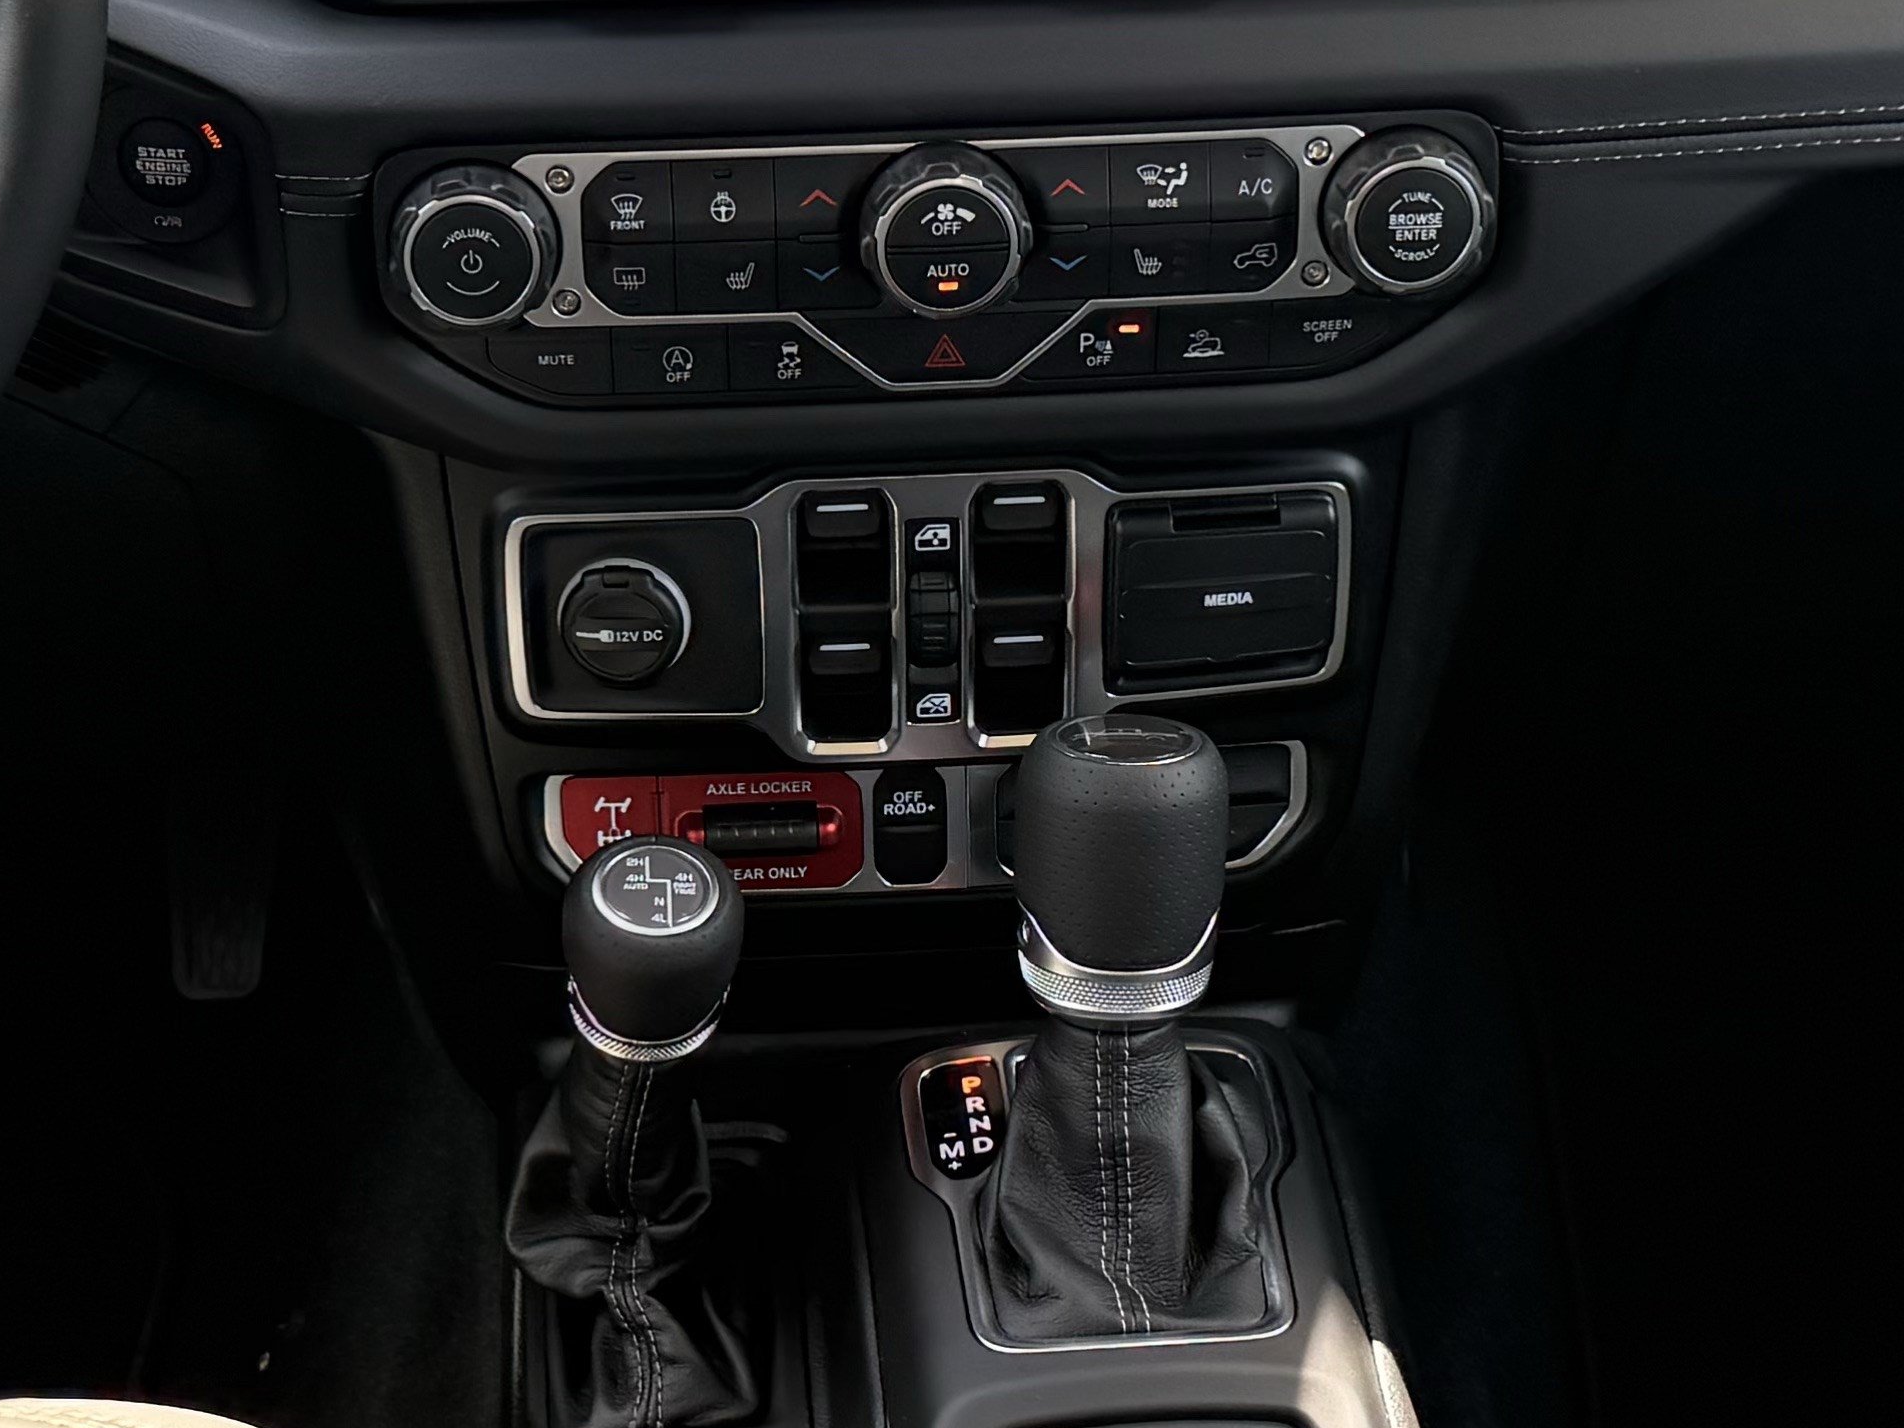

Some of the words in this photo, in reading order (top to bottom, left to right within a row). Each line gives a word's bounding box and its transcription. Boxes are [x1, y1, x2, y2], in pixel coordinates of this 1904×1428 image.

[137, 145, 186, 160] START
[134, 160, 192, 174] ENGINE
[146, 175, 187, 186] STOP
[1238, 178, 1274, 197] A/C
[1147, 197, 1180, 210] MODE
[1401, 191, 1432, 205] TUNE
[610, 219, 646, 231] FRONT
[1388, 212, 1444, 227] BROWSE
[931, 221, 963, 236] OFF
[1395, 228, 1438, 242] ENTER
[445, 227, 493, 246] VOLUME
[1394, 246, 1437, 263] SCROLL
[926, 263, 970, 279] AUTO
[1303, 318, 1353, 333] SCREEN
[1314, 331, 1339, 344] OFF
[538, 353, 575, 367] MUTE
[1086, 354, 1112, 368] OFF
[665, 369, 692, 384] OFF
[776, 365, 803, 380] OFF
[1203, 590, 1254, 608] MEDIA
[615, 630, 641, 644] 12V
[642, 628, 664, 643] DC
[705, 782, 747, 796] AXLE
[750, 780, 813, 795] LOCKER
[892, 790, 923, 804] OFF
[882, 801, 937, 816] ROAD+
[625, 873, 645, 883] 4H
[767, 865, 809, 880] ONLY
[653, 896, 666, 907] N
[650, 912, 667, 924] 4L
[961, 1076, 982, 1094] P
[965, 1096, 986, 1114] R
[968, 1115, 992, 1133] N
[939, 1140, 966, 1160] M
[972, 1136, 994, 1154] D
